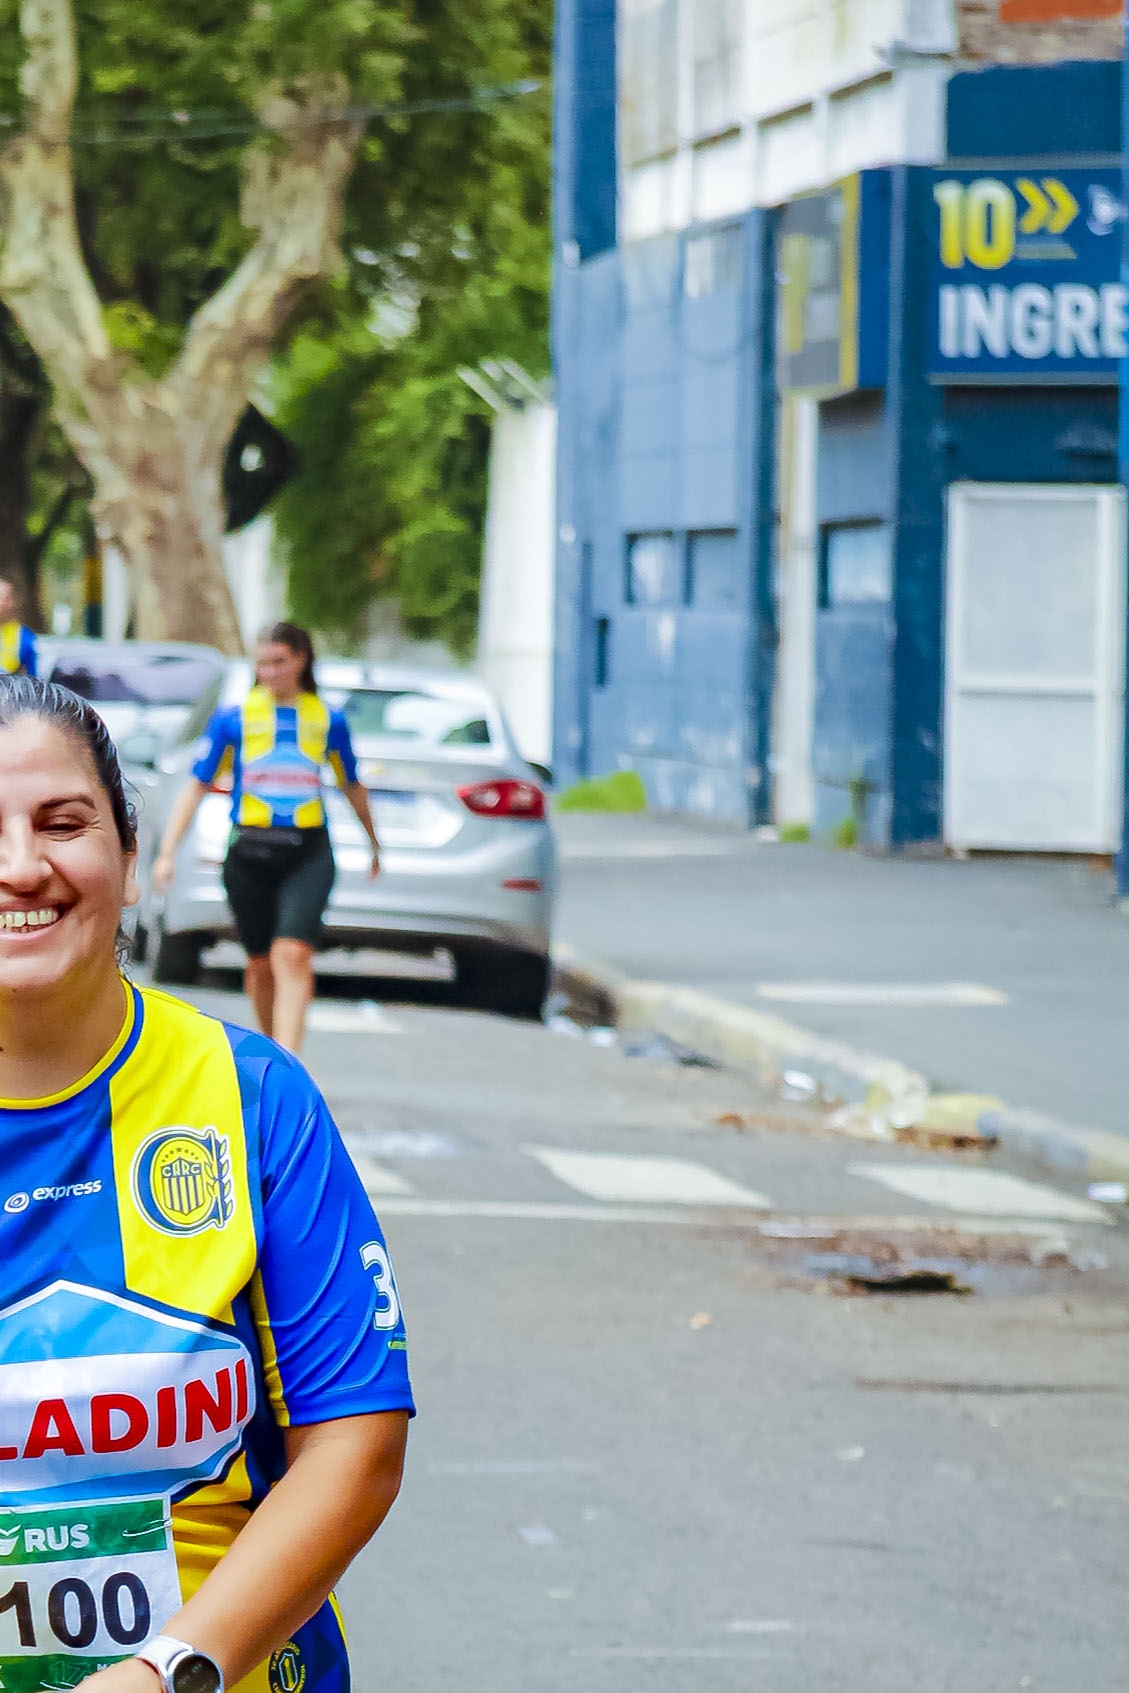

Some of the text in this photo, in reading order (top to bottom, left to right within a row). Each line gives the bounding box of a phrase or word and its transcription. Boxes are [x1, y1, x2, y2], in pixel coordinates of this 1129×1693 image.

[933, 177, 1016, 269] 10
[32, 1180, 102, 1200] express
[23, 1524, 91, 1553] RUS
